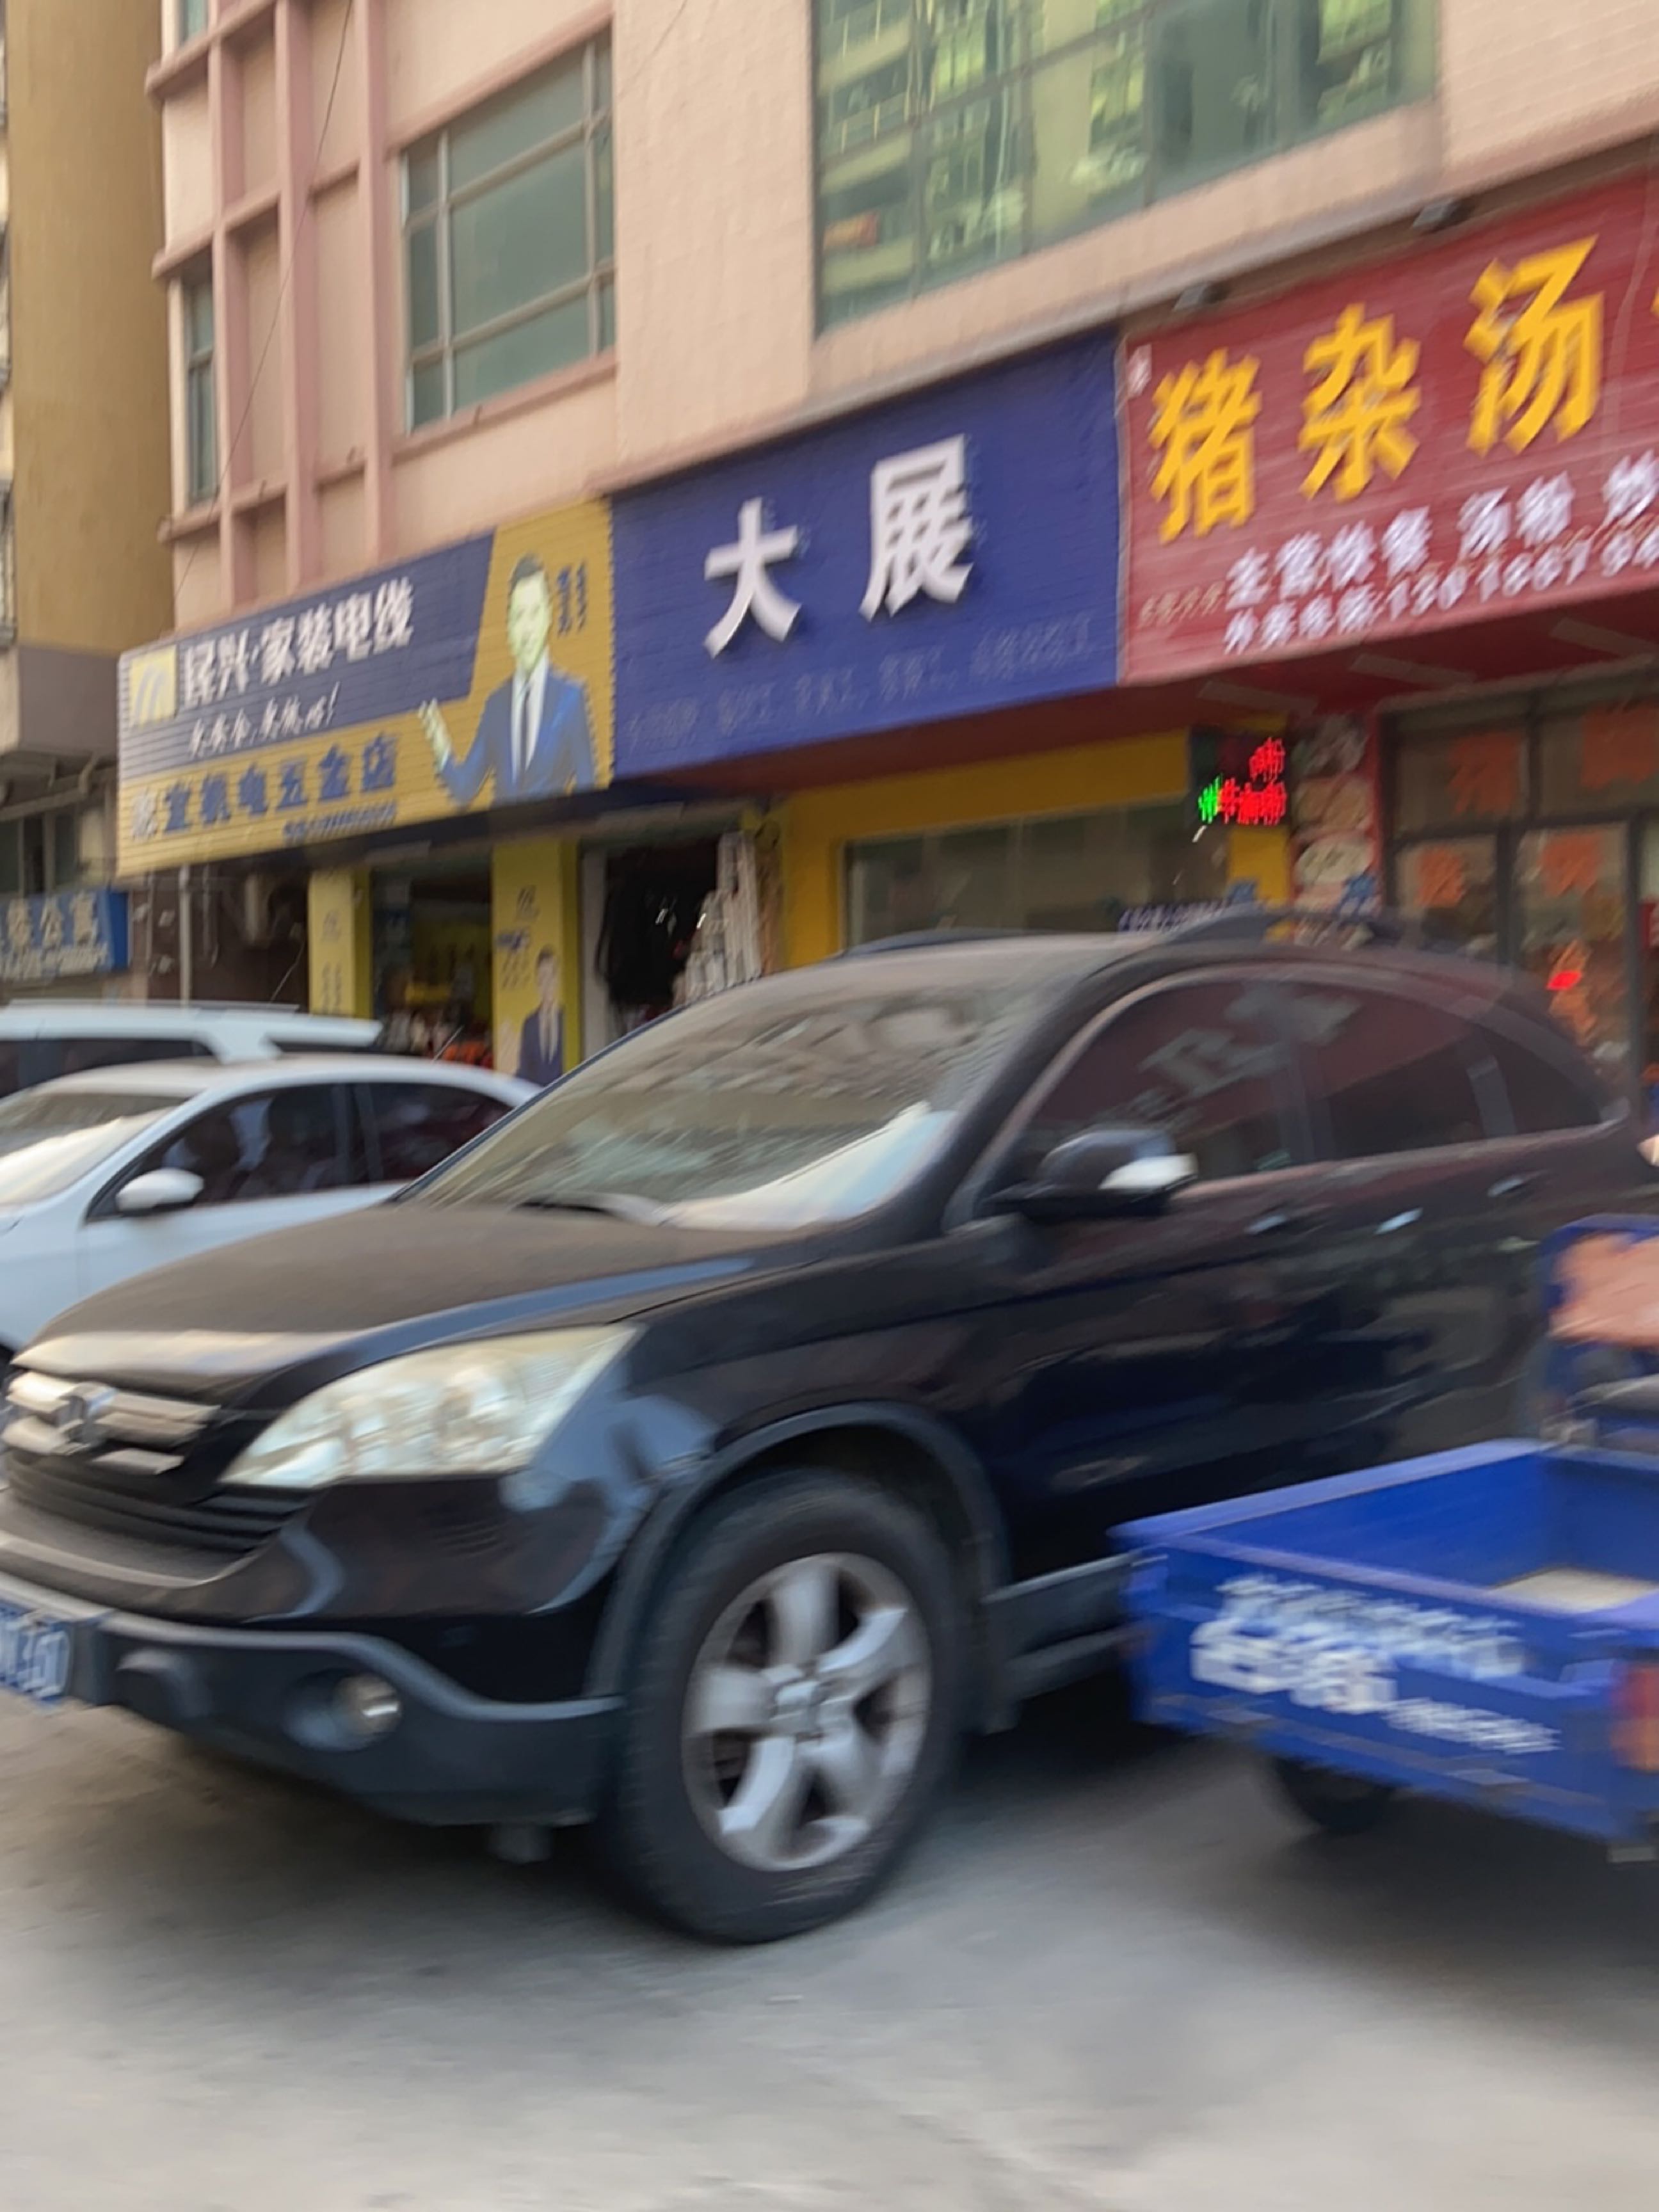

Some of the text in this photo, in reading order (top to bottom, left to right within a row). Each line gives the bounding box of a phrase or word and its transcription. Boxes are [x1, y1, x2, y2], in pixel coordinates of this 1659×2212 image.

[1148, 233, 1659, 546] 猪杂汤
[701, 433, 975, 659] 大展
